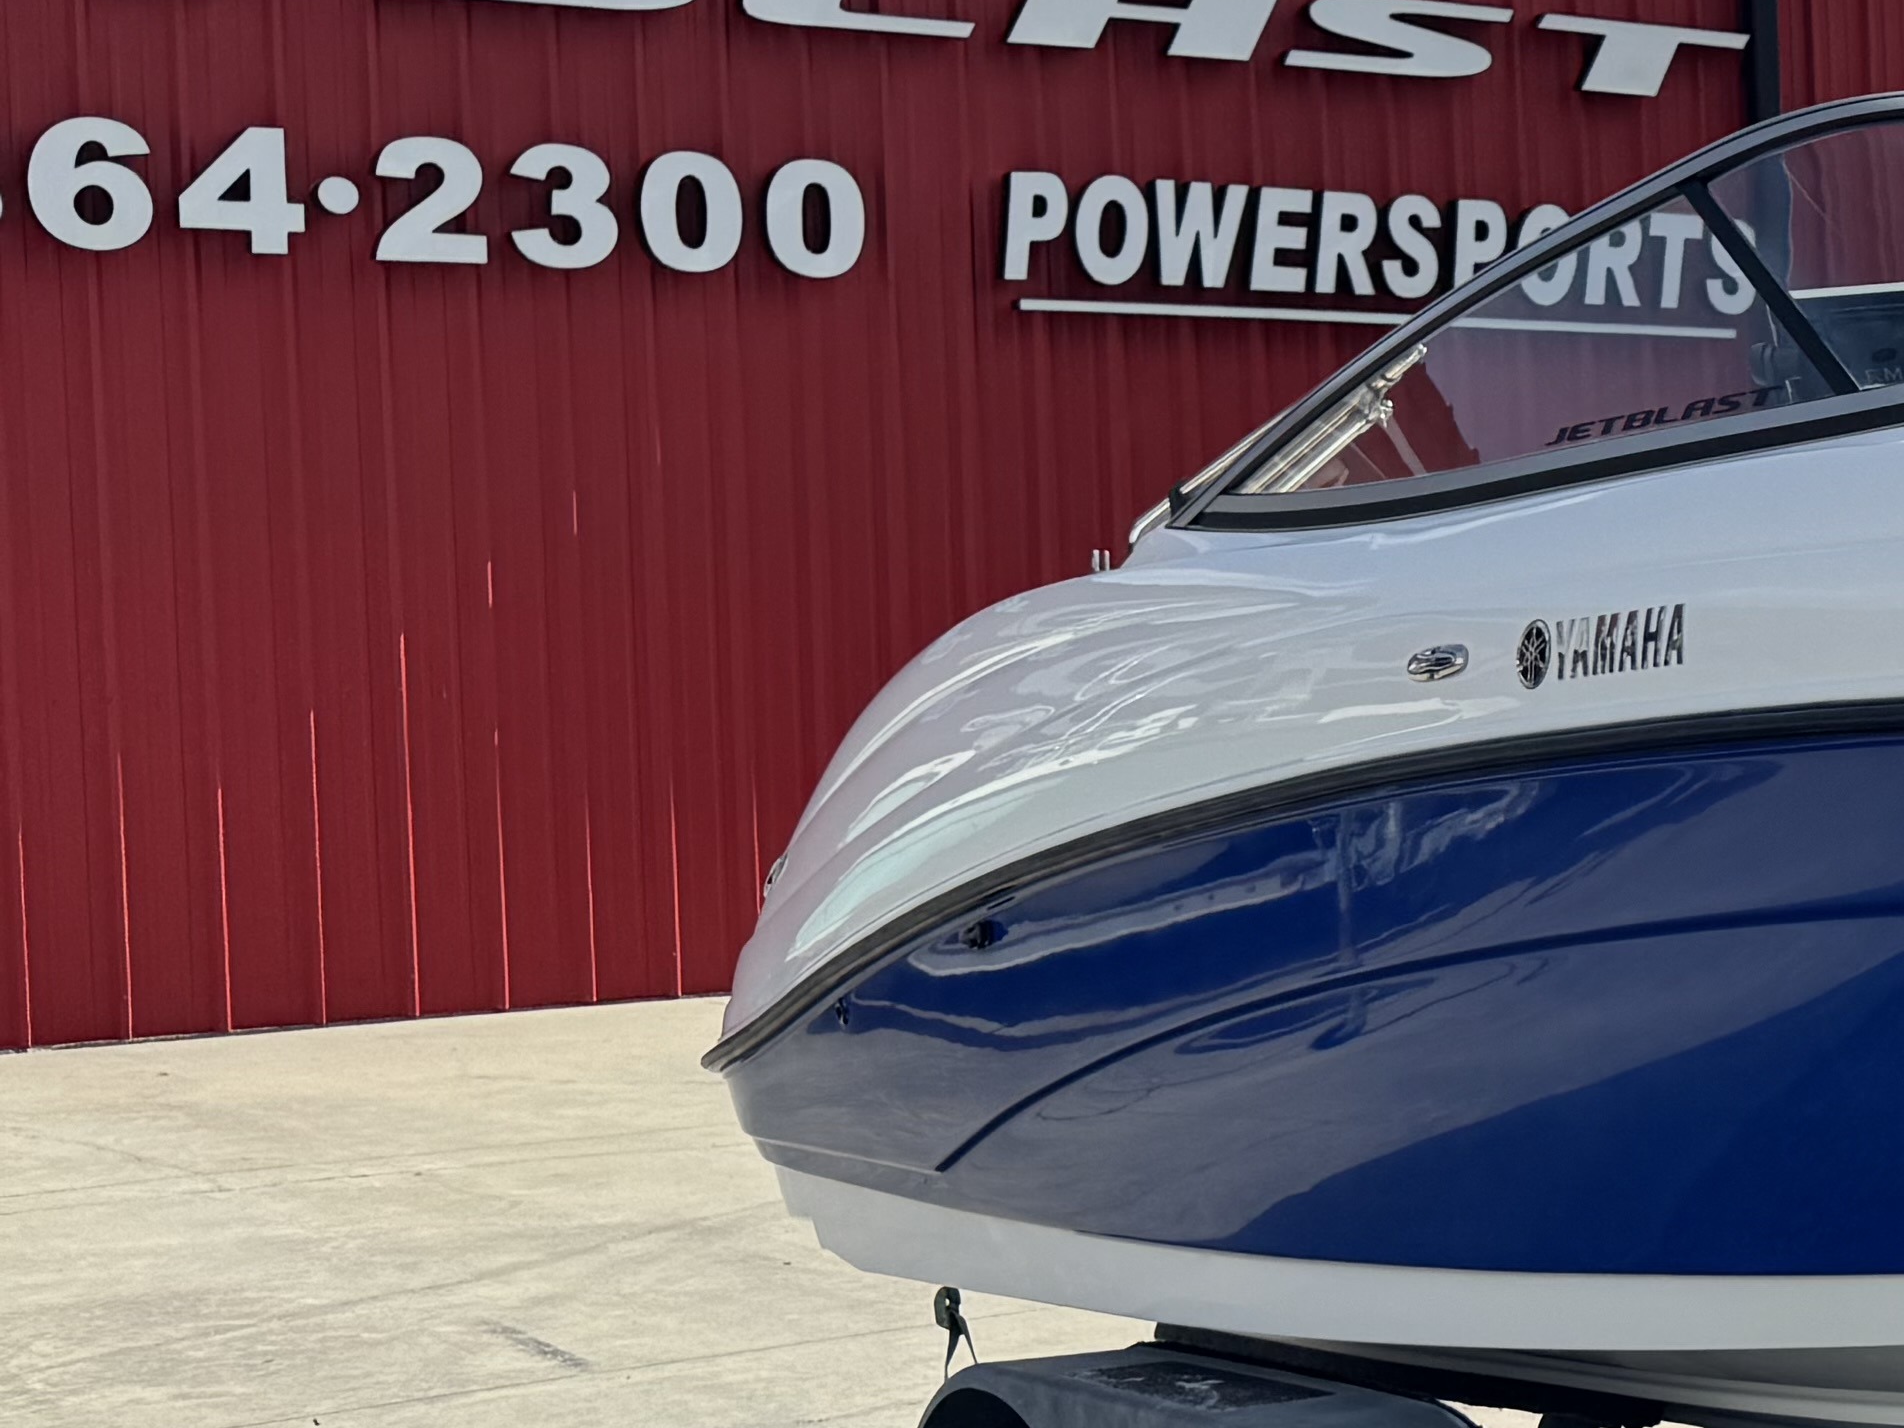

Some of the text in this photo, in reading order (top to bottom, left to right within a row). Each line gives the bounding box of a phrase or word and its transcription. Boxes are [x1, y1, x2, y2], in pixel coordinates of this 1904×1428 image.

[1003, 171, 1757, 317] POWERSPORTS
[1544, 386, 1781, 447] JETBLAST
[1555, 603, 1686, 681] YAMAHA
